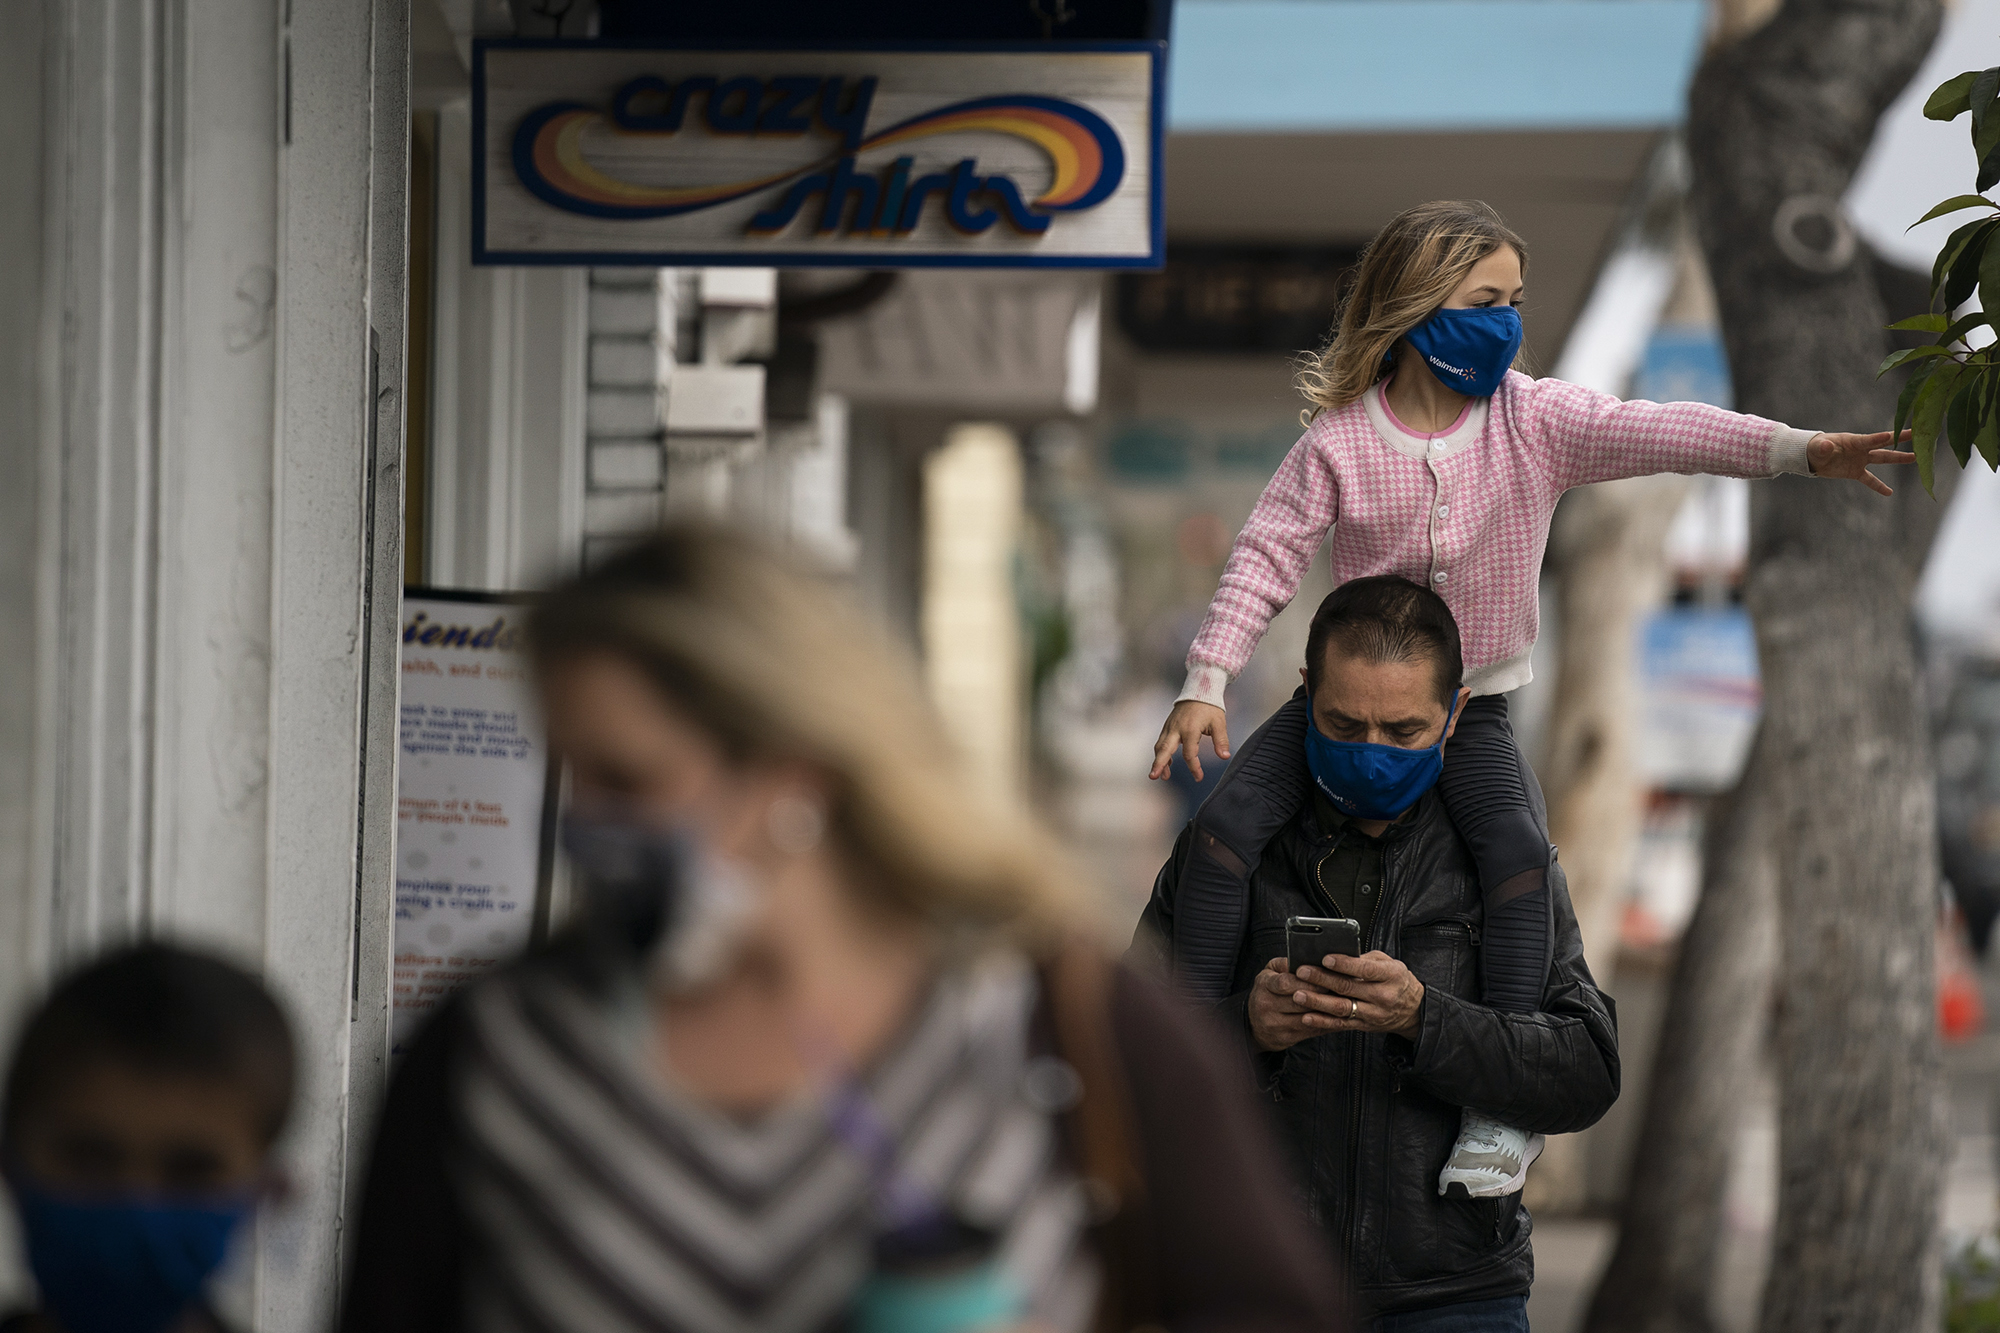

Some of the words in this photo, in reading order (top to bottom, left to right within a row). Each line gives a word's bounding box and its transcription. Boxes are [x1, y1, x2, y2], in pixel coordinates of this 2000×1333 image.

[612, 72, 879, 149] crazy
[746, 152, 1053, 237] shirts
[1429, 355, 1464, 376] Walmart
[403, 610, 517, 649] iends
[1316, 775, 1344, 803] Walmart
[396, 879, 453, 895] omplete
[450, 898, 495, 912] credit
